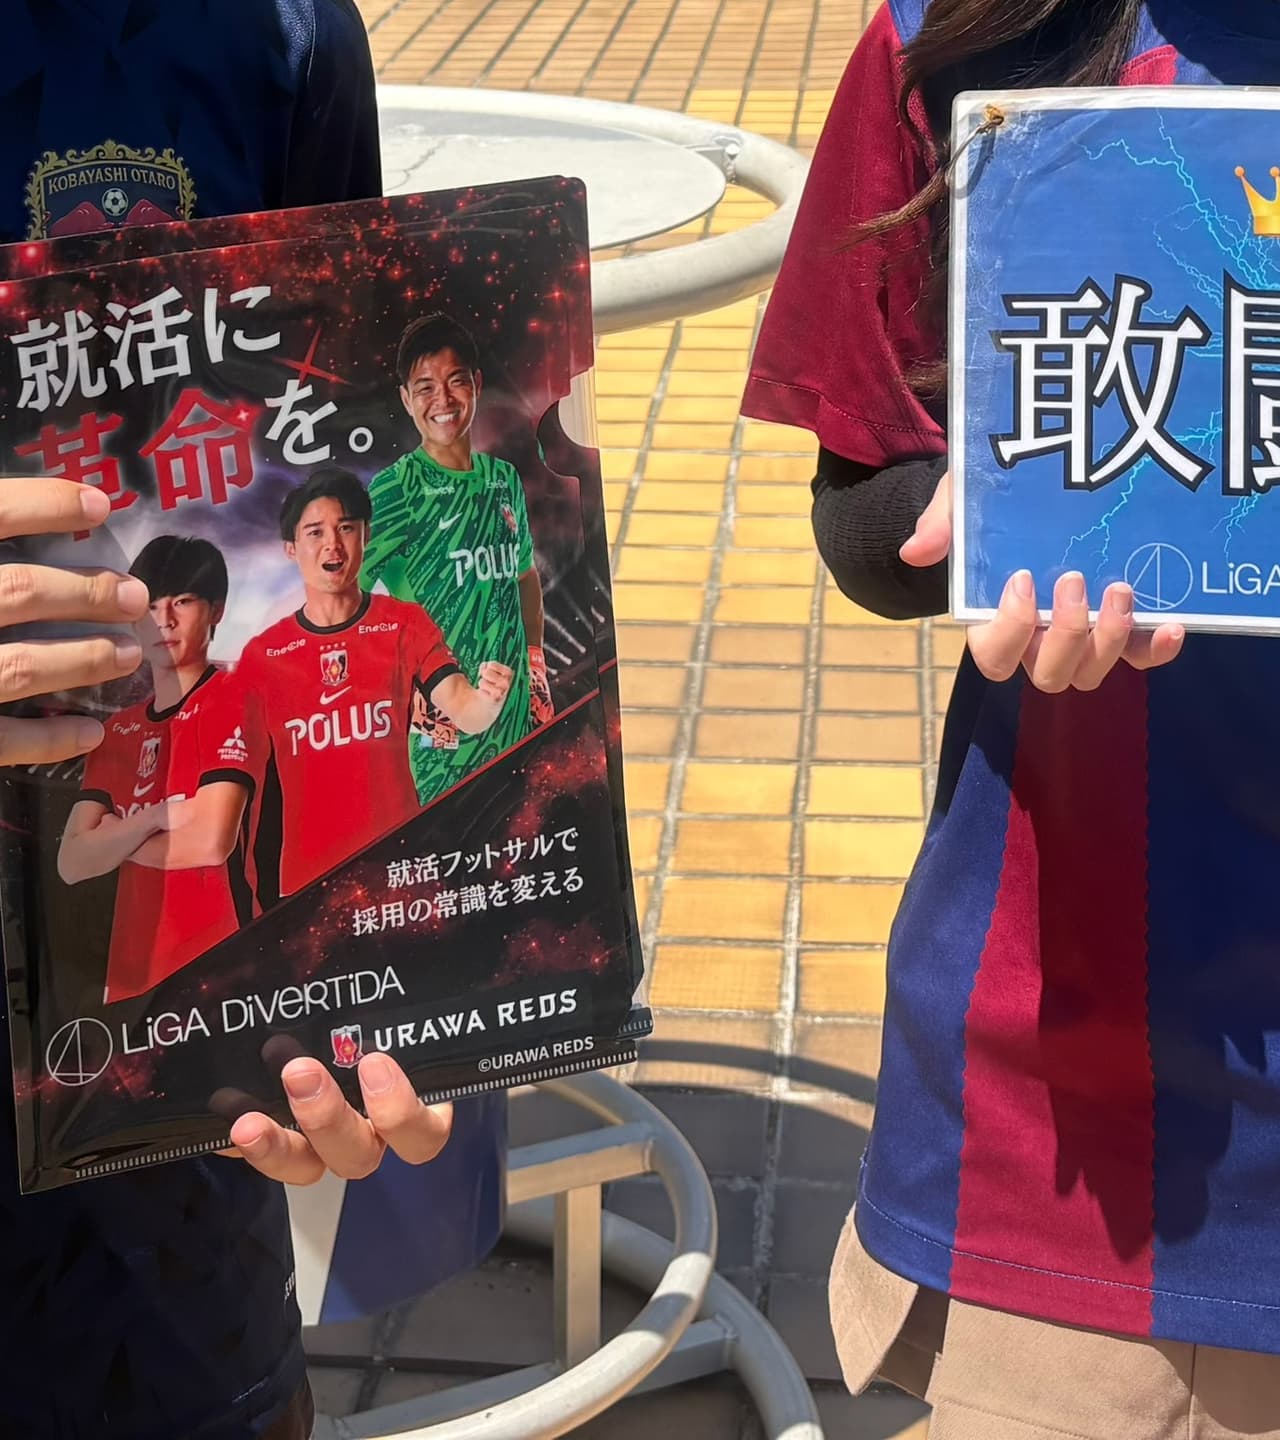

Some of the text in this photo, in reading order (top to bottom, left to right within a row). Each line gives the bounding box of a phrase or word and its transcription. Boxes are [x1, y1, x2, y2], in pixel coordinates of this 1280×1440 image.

[48, 167, 176, 195] KOBAYASHI OTARO
[10, 285, 281, 413] 就活に
[14, 378, 374, 542] 革命を。
[284, 699, 393, 756] POLUS
[386, 827, 580, 890] 就活フットサルで
[352, 866, 584, 937] 採用の常識を変える
[375, 988, 578, 1052] URAWA REDS
[478, 1036, 595, 1073] ©URAWA REDS
